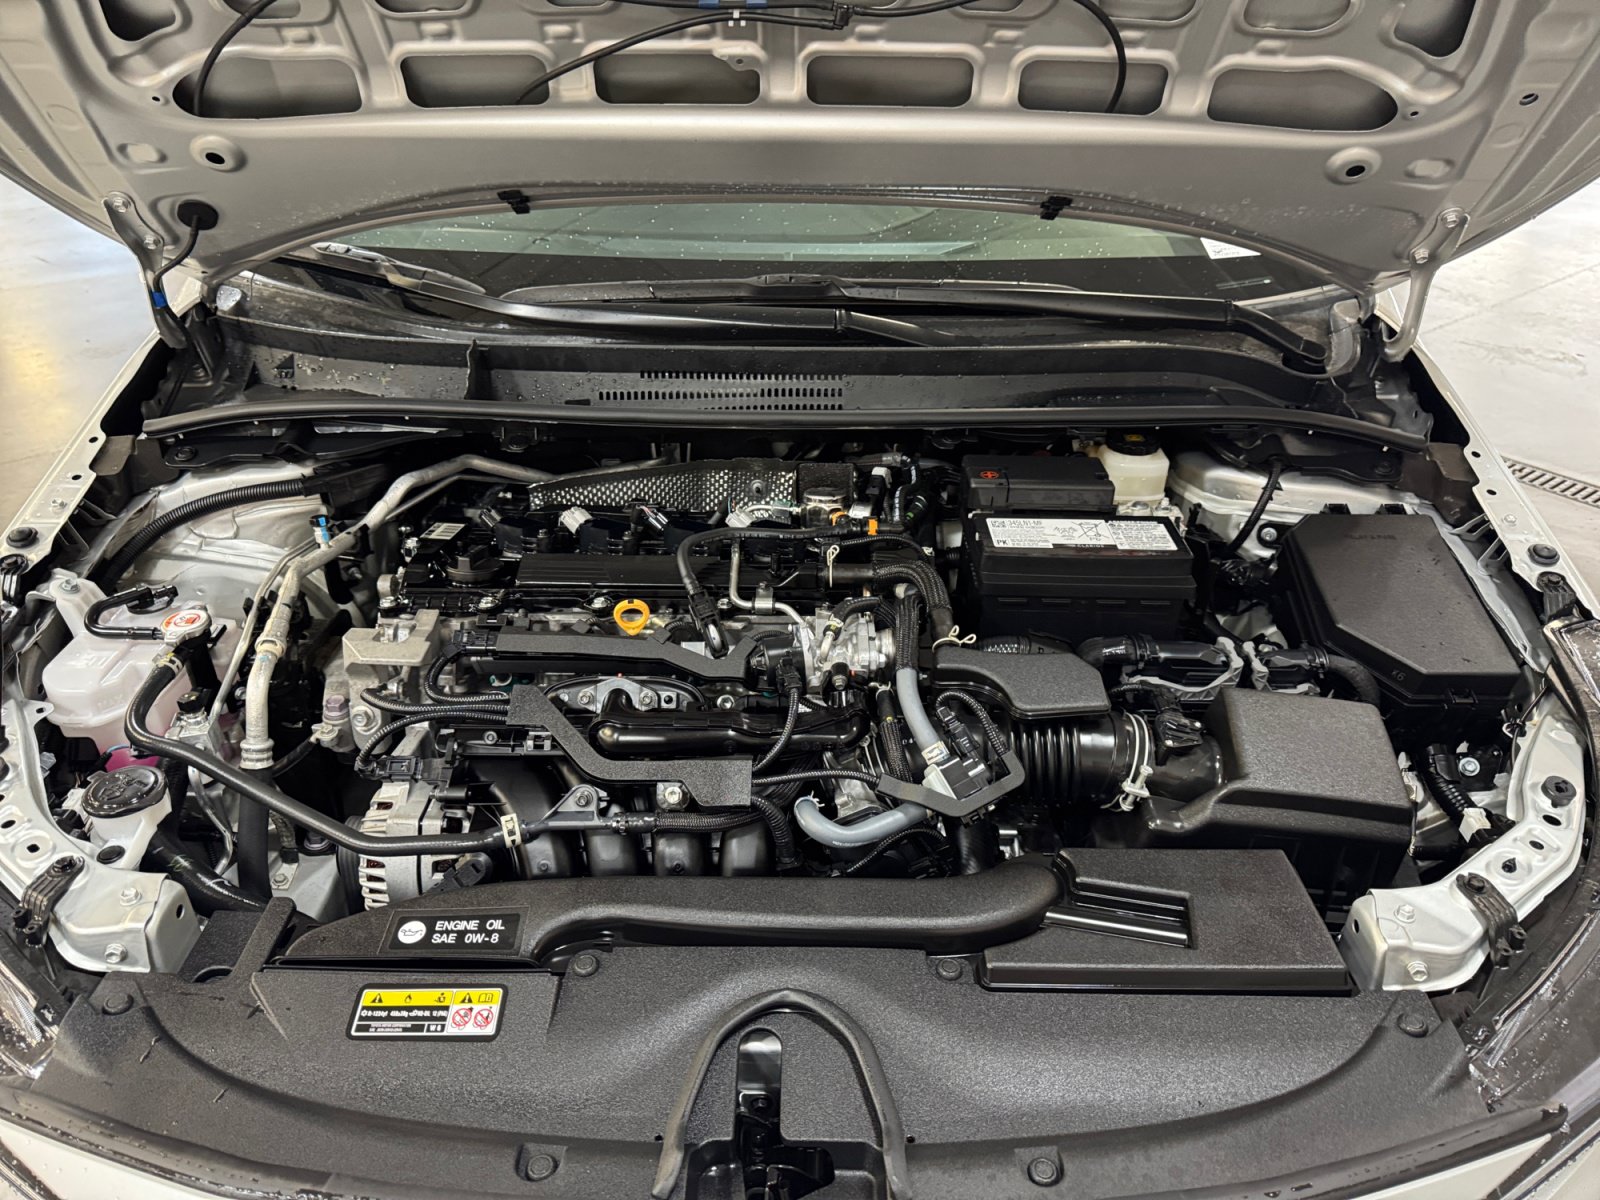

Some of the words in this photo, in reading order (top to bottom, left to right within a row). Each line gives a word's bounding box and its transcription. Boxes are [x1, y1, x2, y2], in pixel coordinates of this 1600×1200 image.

[435, 920, 480, 931] ENGINE
[486, 919, 506, 930] OIL
[431, 933, 457, 944] SAE
[464, 932, 500, 944] 0W-8
